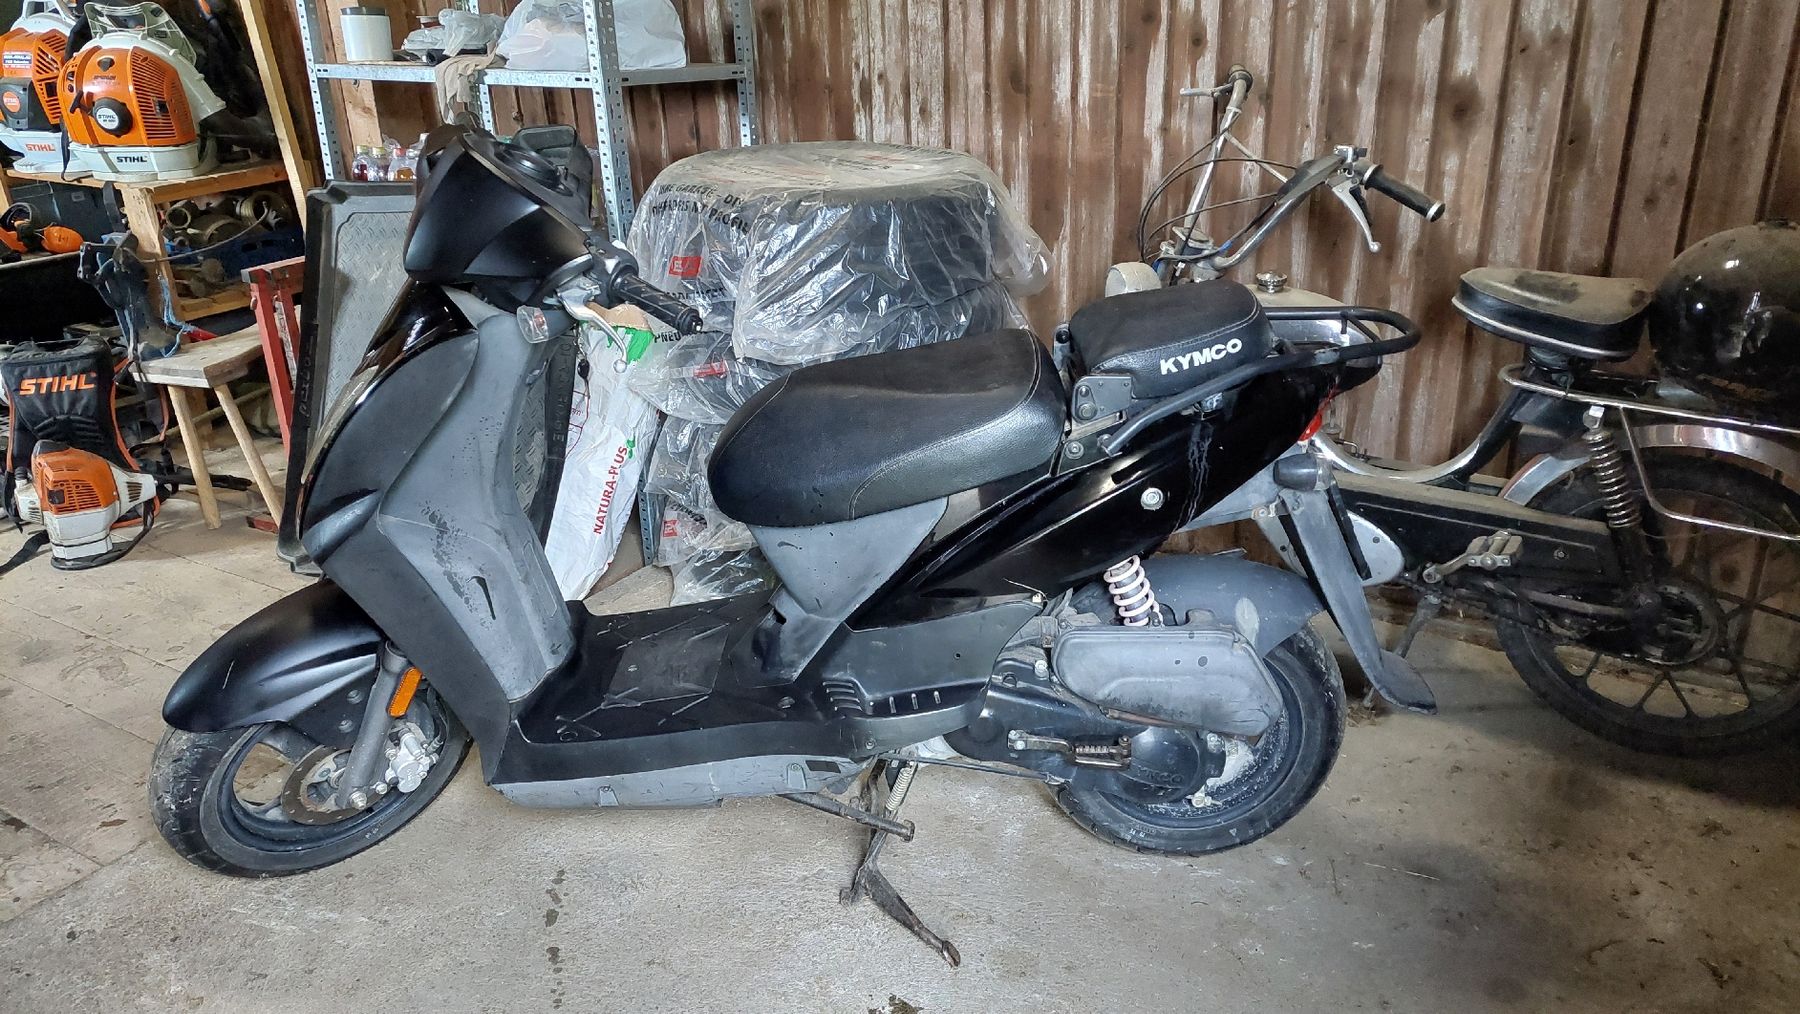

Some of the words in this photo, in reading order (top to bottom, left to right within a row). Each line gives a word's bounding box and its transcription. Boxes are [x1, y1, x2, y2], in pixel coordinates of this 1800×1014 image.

[26, 143, 56, 152] STIHL
[1160, 338, 1242, 375] KYMCO
[20, 374, 95, 395] STIHL
[593, 446, 628, 535] NATURA-PLUS
